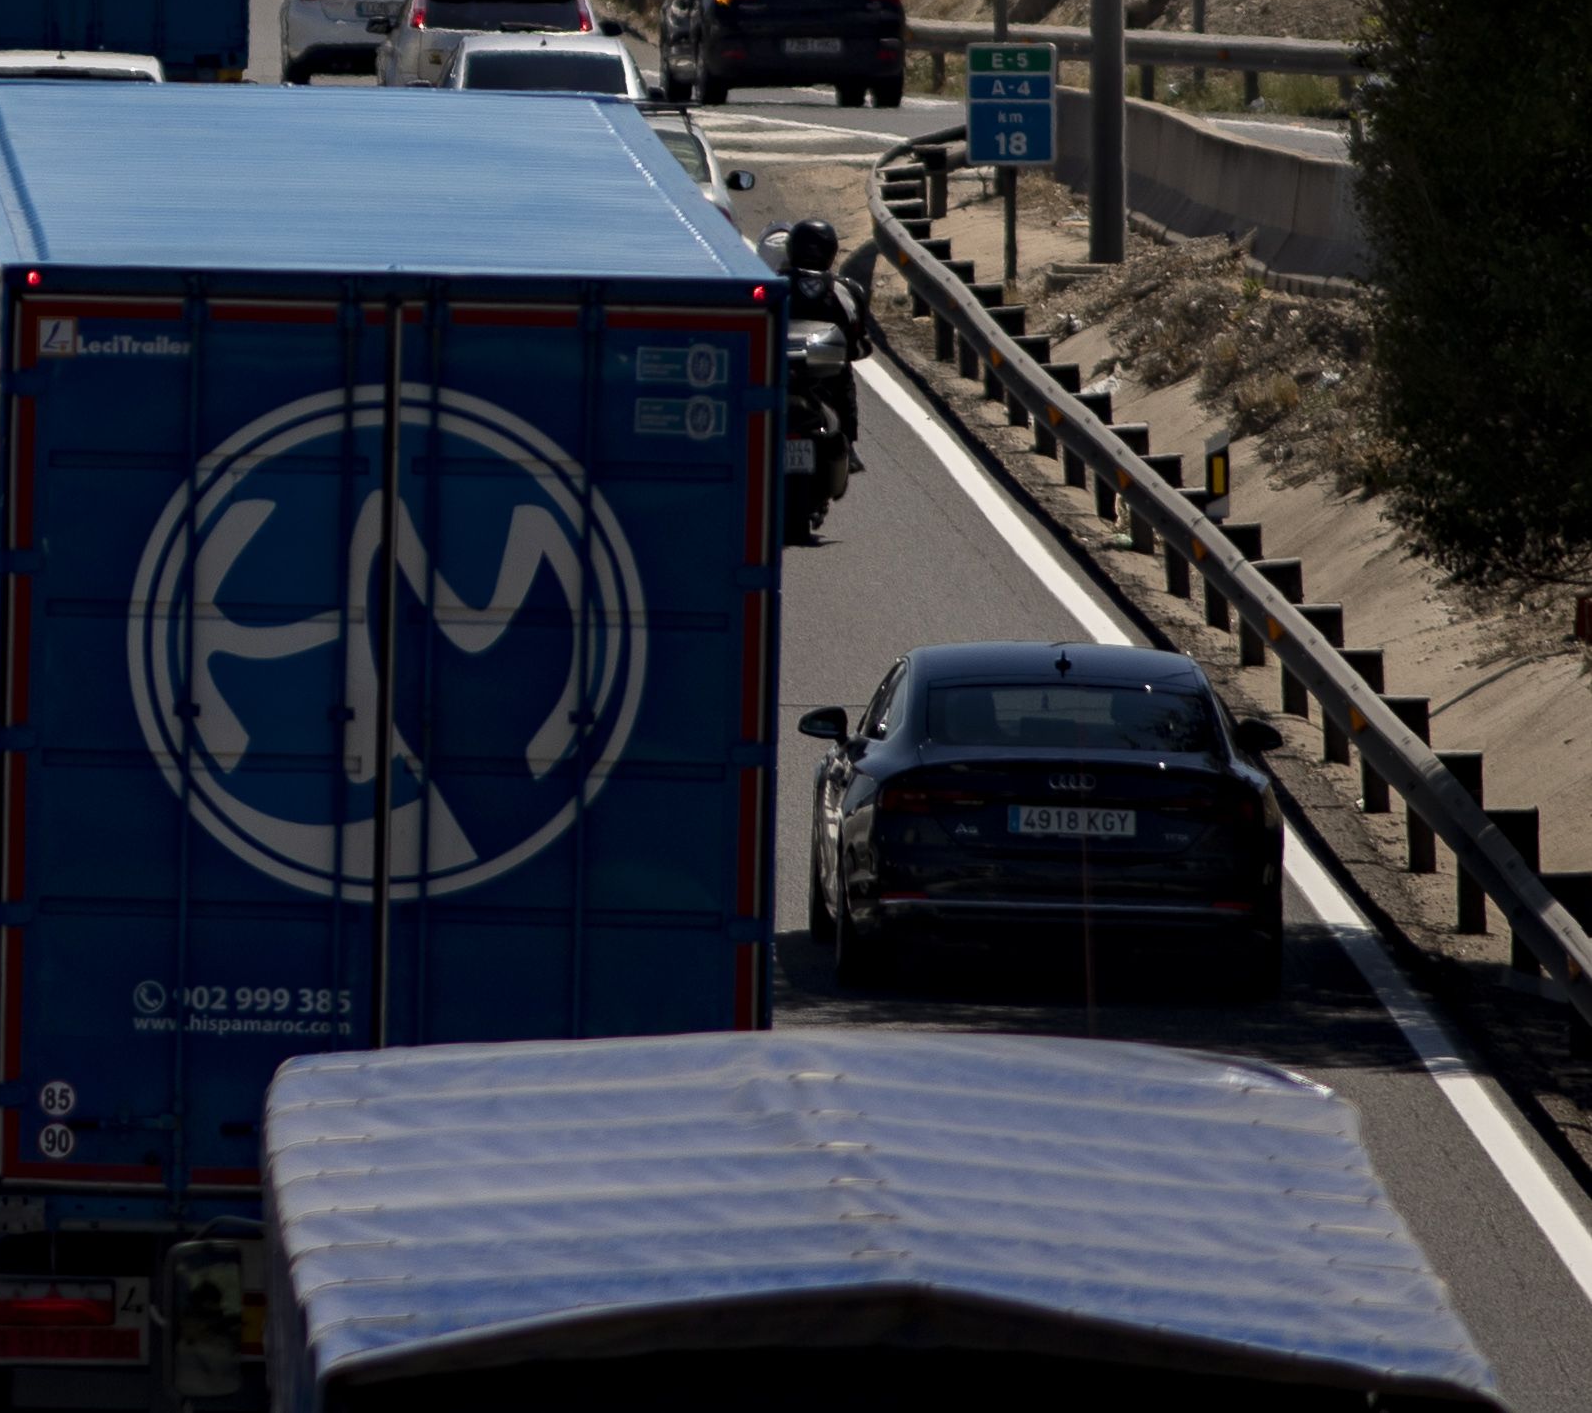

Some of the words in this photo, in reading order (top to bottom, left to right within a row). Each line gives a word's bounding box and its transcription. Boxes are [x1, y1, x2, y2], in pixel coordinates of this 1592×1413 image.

[991, 52, 1029, 69] E-5
[991, 79, 1031, 96] A-4
[997, 110, 1024, 124] km
[994, 131, 1029, 157] 18
[76, 333, 192, 355] LeciTrailer
[1023, 809, 1080, 831] 4918
[1087, 811, 1130, 833] KGY
[235, 985, 291, 1014] 999
[296, 987, 352, 1015] 385
[44, 1086, 71, 1110] 85
[44, 1129, 71, 1153] 90
